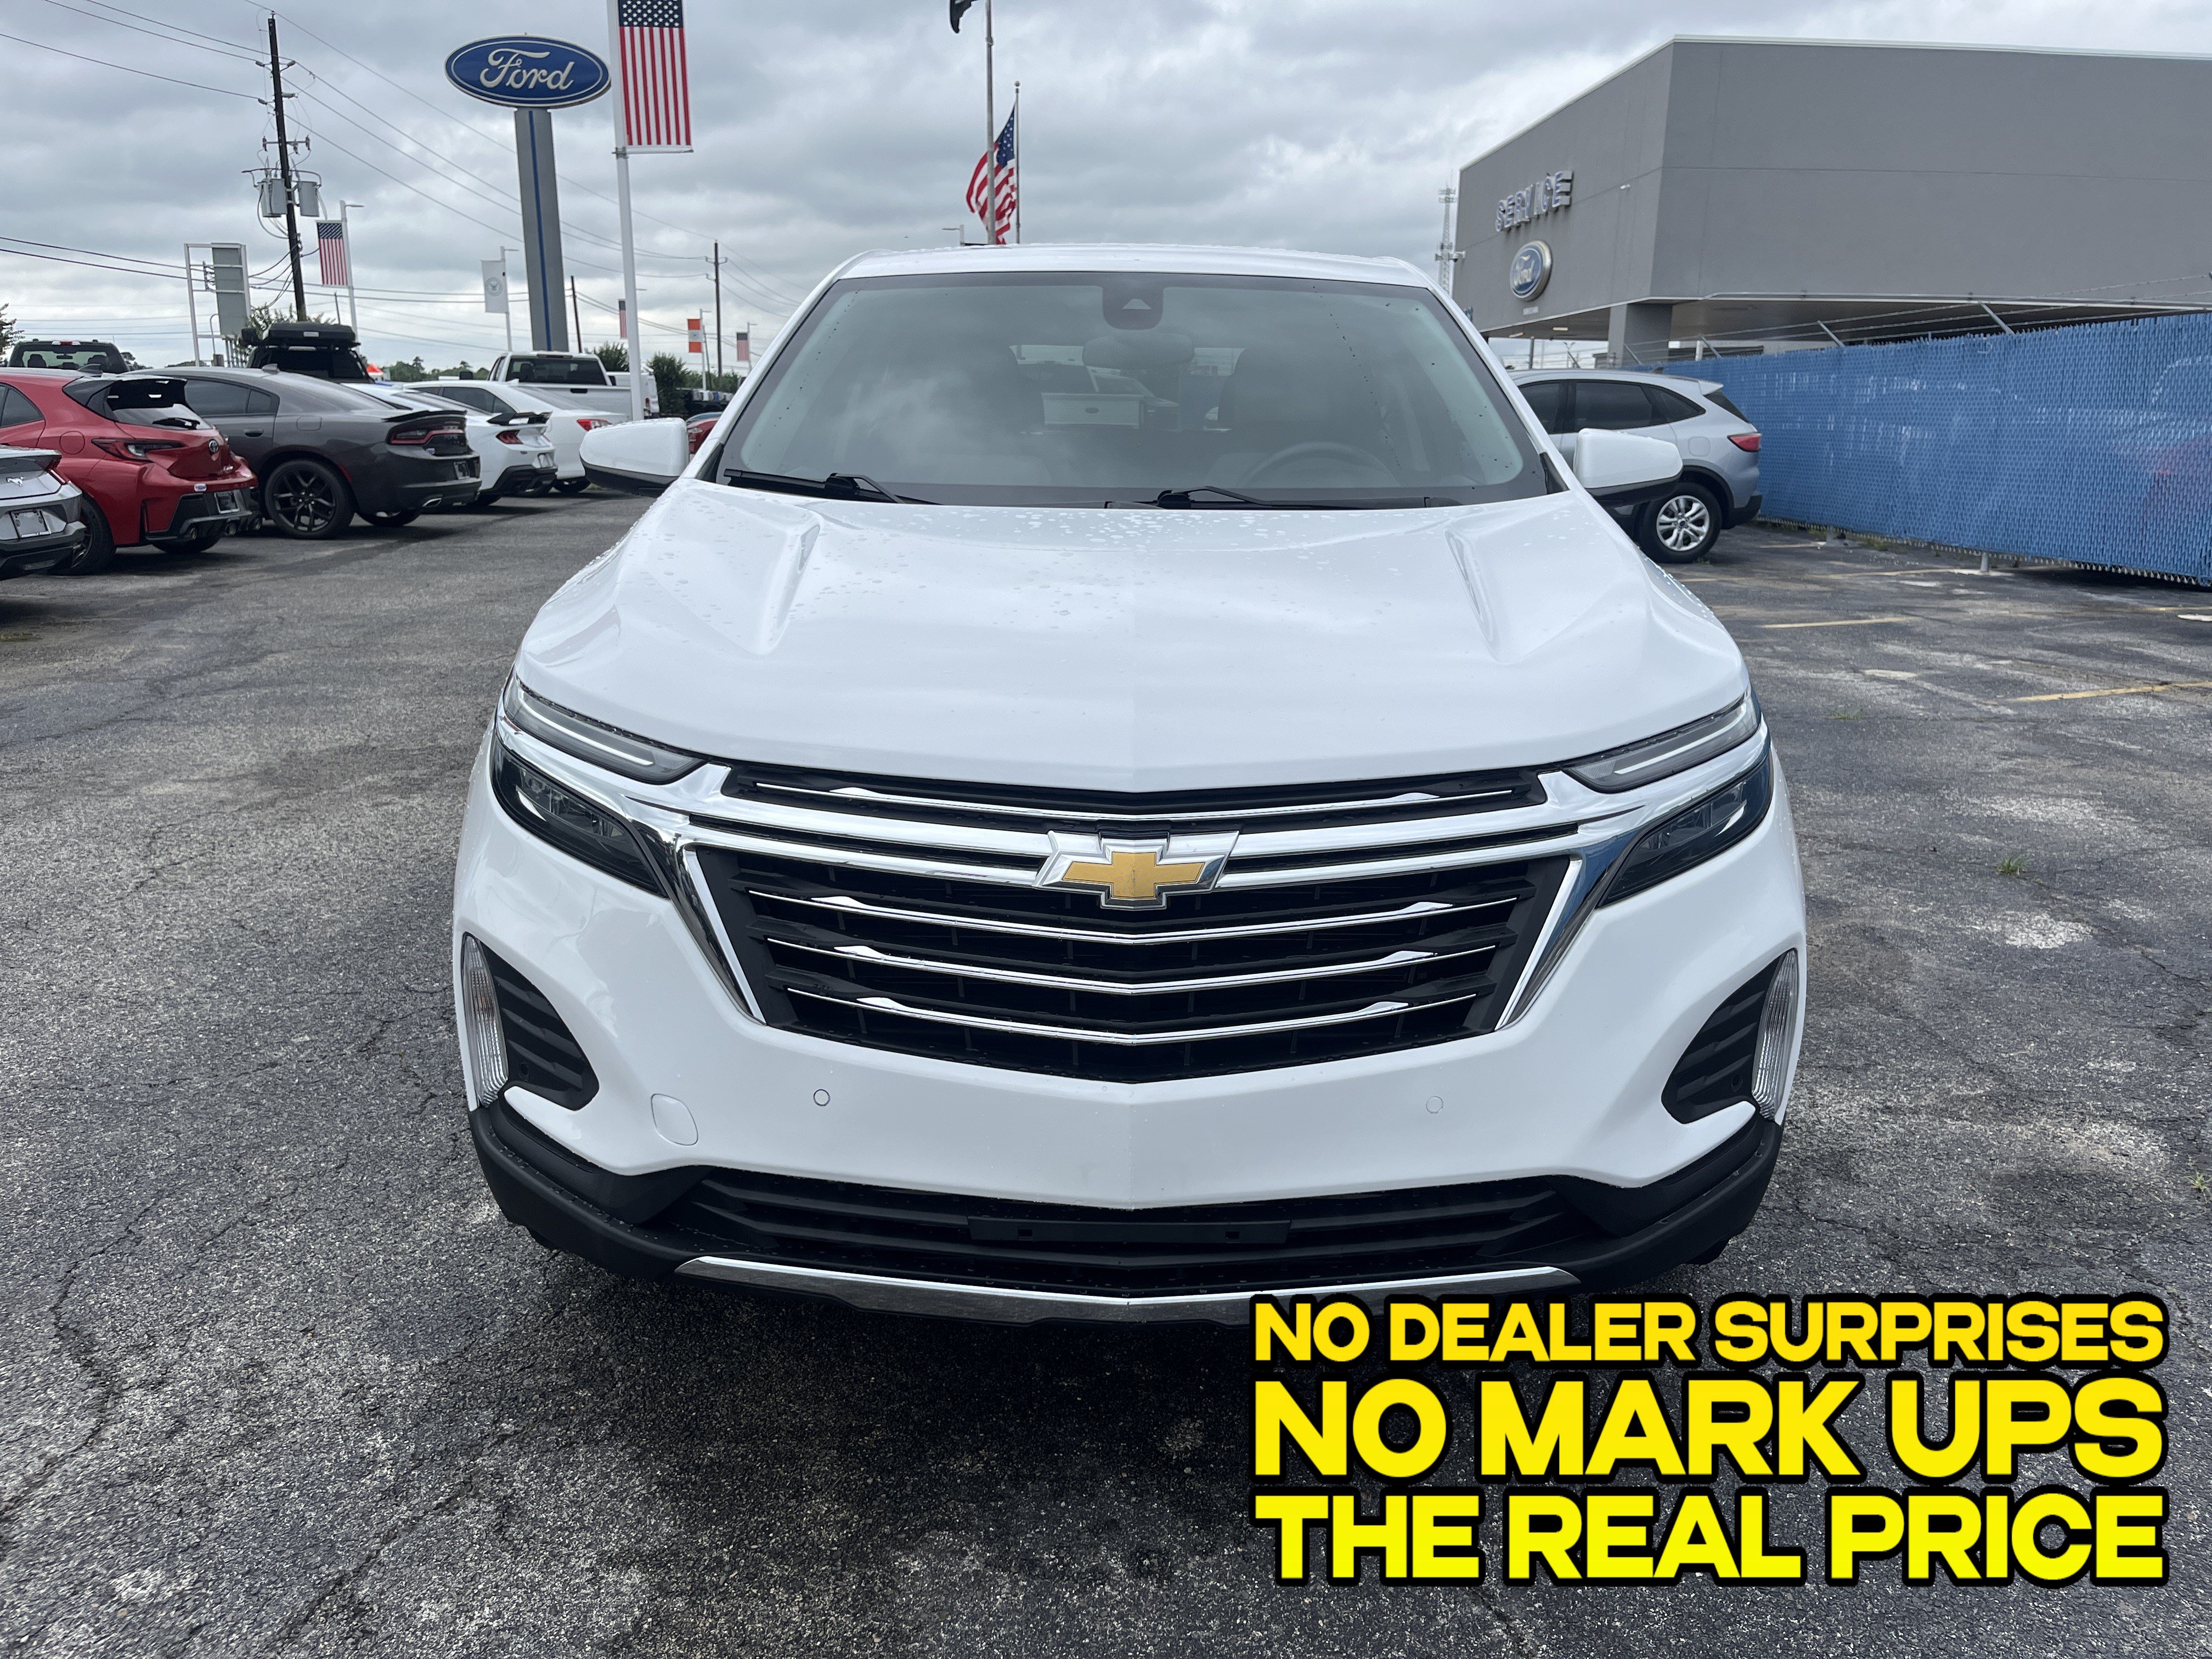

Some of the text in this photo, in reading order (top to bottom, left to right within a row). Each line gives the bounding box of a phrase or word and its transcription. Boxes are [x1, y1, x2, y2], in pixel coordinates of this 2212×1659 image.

[480, 48, 575, 91] Ford
[1496, 170, 1573, 232] SERVICE
[1514, 254, 1536, 286] Ford
